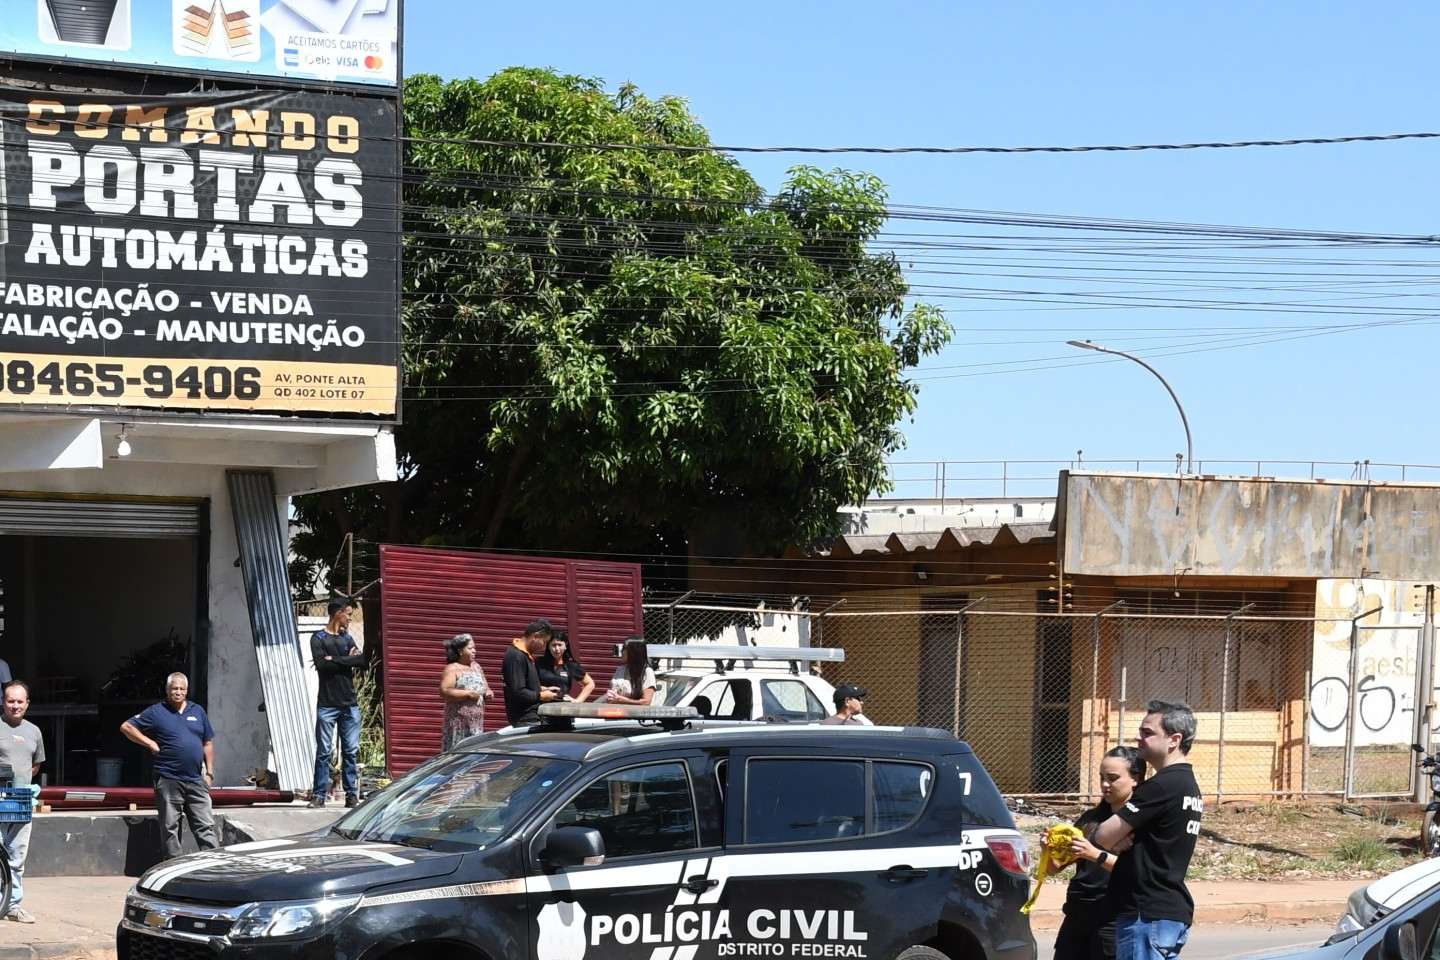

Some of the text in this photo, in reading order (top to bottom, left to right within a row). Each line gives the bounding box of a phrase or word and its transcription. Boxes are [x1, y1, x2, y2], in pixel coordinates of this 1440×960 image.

[288, 35, 380, 52] ACEITAMOS CARTÕES
[336, 57, 359, 67] VISA
[25, 99, 359, 154] COMANDO
[27, 139, 363, 228] PORTAS
[24, 224, 369, 278] AUTOMÁTICAS
[210, 291, 314, 317] VENDA
[155, 318, 366, 352] MANUTENÇÃO
[296, 374, 334, 385] PONTE
[338, 375, 367, 386] ALTA
[273, 387, 365, 400] QD 402 LOTE 07
[591, 904, 868, 946] POLÍCIA CIVIL
[718, 942, 867, 958] DSTRITO FEDERAL
